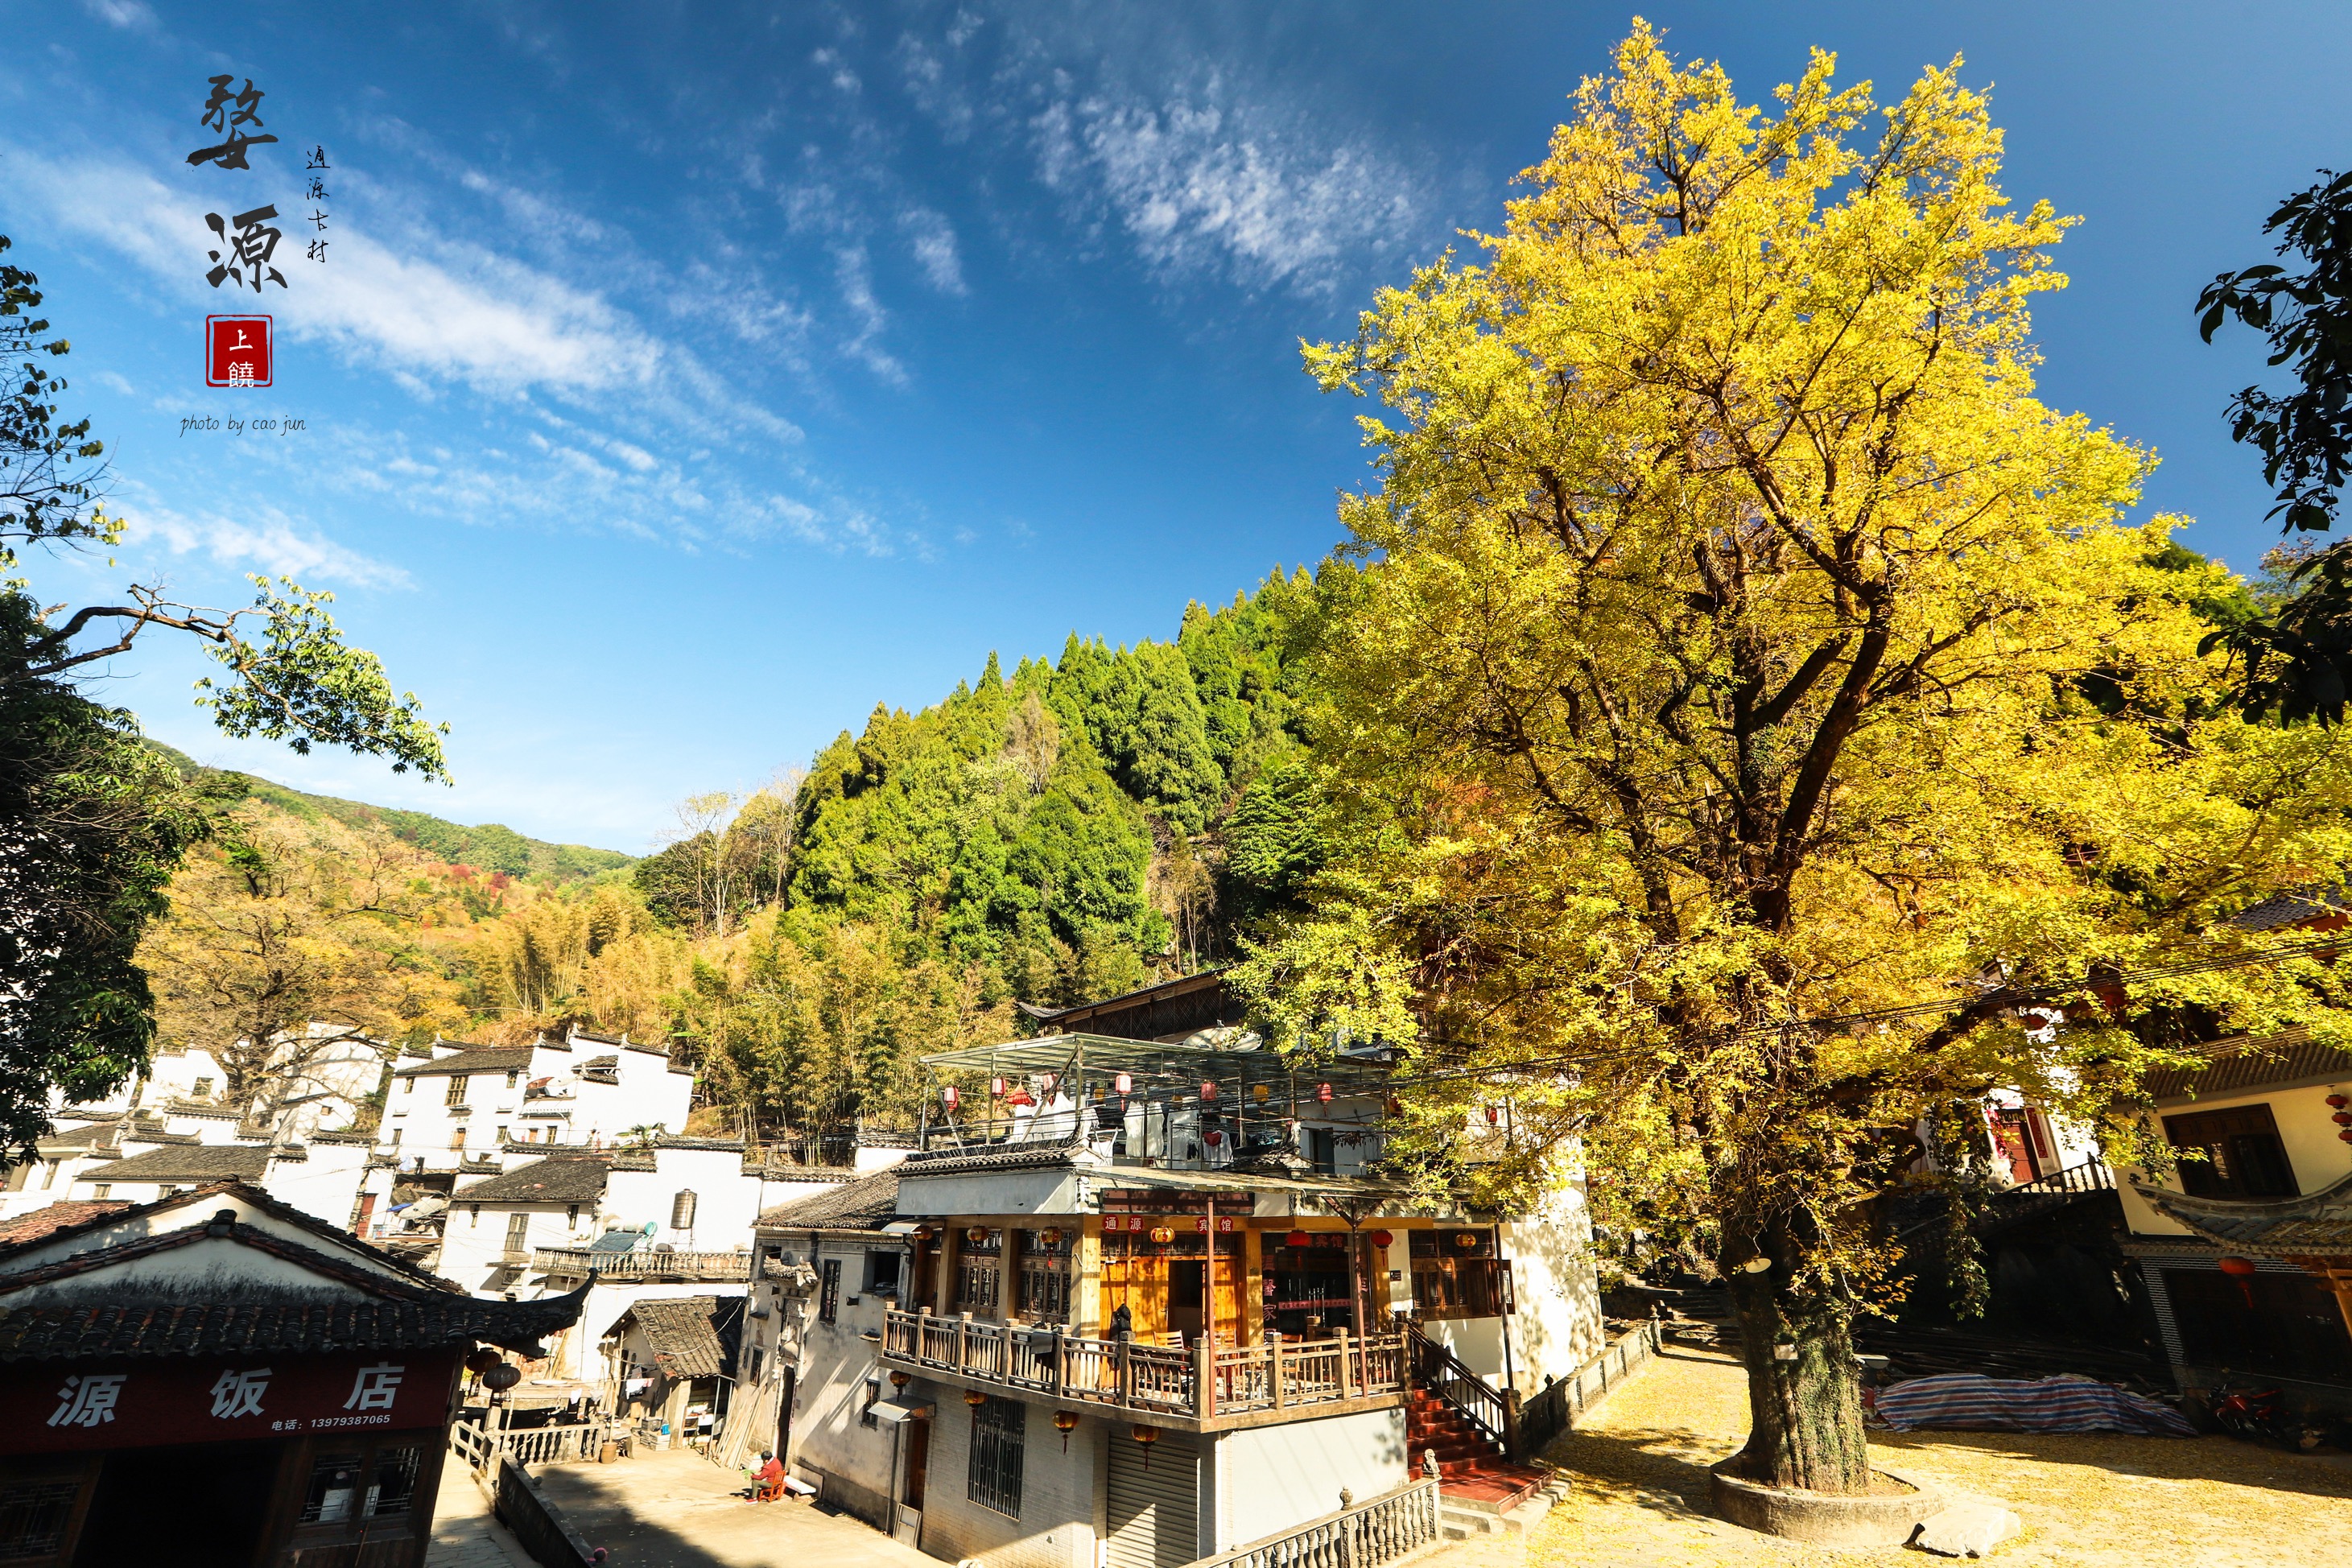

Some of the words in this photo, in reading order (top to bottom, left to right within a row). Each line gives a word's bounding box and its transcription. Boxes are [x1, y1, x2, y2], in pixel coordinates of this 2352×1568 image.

[1104, 1216, 1232, 1232] 通源宾馆
[46, 1360, 406, 1429] 源饭店
